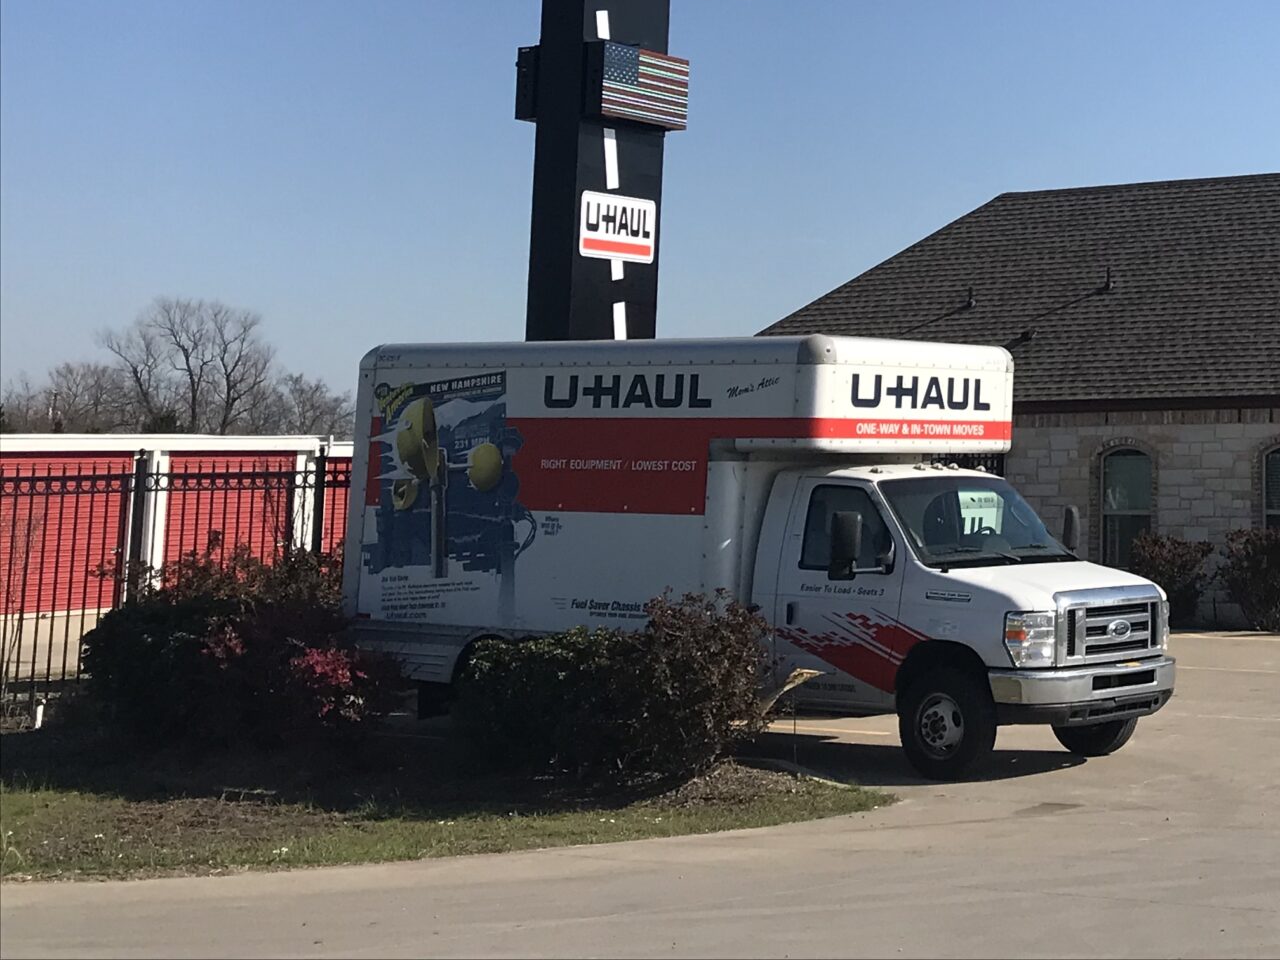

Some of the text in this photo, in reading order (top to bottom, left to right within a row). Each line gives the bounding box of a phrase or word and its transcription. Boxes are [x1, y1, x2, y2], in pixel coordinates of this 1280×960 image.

[586, 201, 651, 239] U-HAUL
[430, 382, 449, 393] NEW
[451, 374, 502, 390] HAMPSHIRE
[543, 374, 712, 409] U-HAUL
[851, 373, 991, 411] U-HAUL
[856, 423, 985, 436] ONE-WAY & IN-TOWN MOVES
[540, 458, 567, 469] RIGHT
[569, 459, 622, 470] EQUIPMENT
[631, 460, 669, 471] LOWEST
[671, 460, 697, 471] COST
[800, 583, 823, 593] Easier
[824, 585, 832, 593] To
[833, 585, 852, 594] Load
[857, 587, 878, 596] Seats
[571, 599, 588, 609] Fuel
[588, 598, 610, 610] Saver
[611, 600, 642, 612] Chassis
